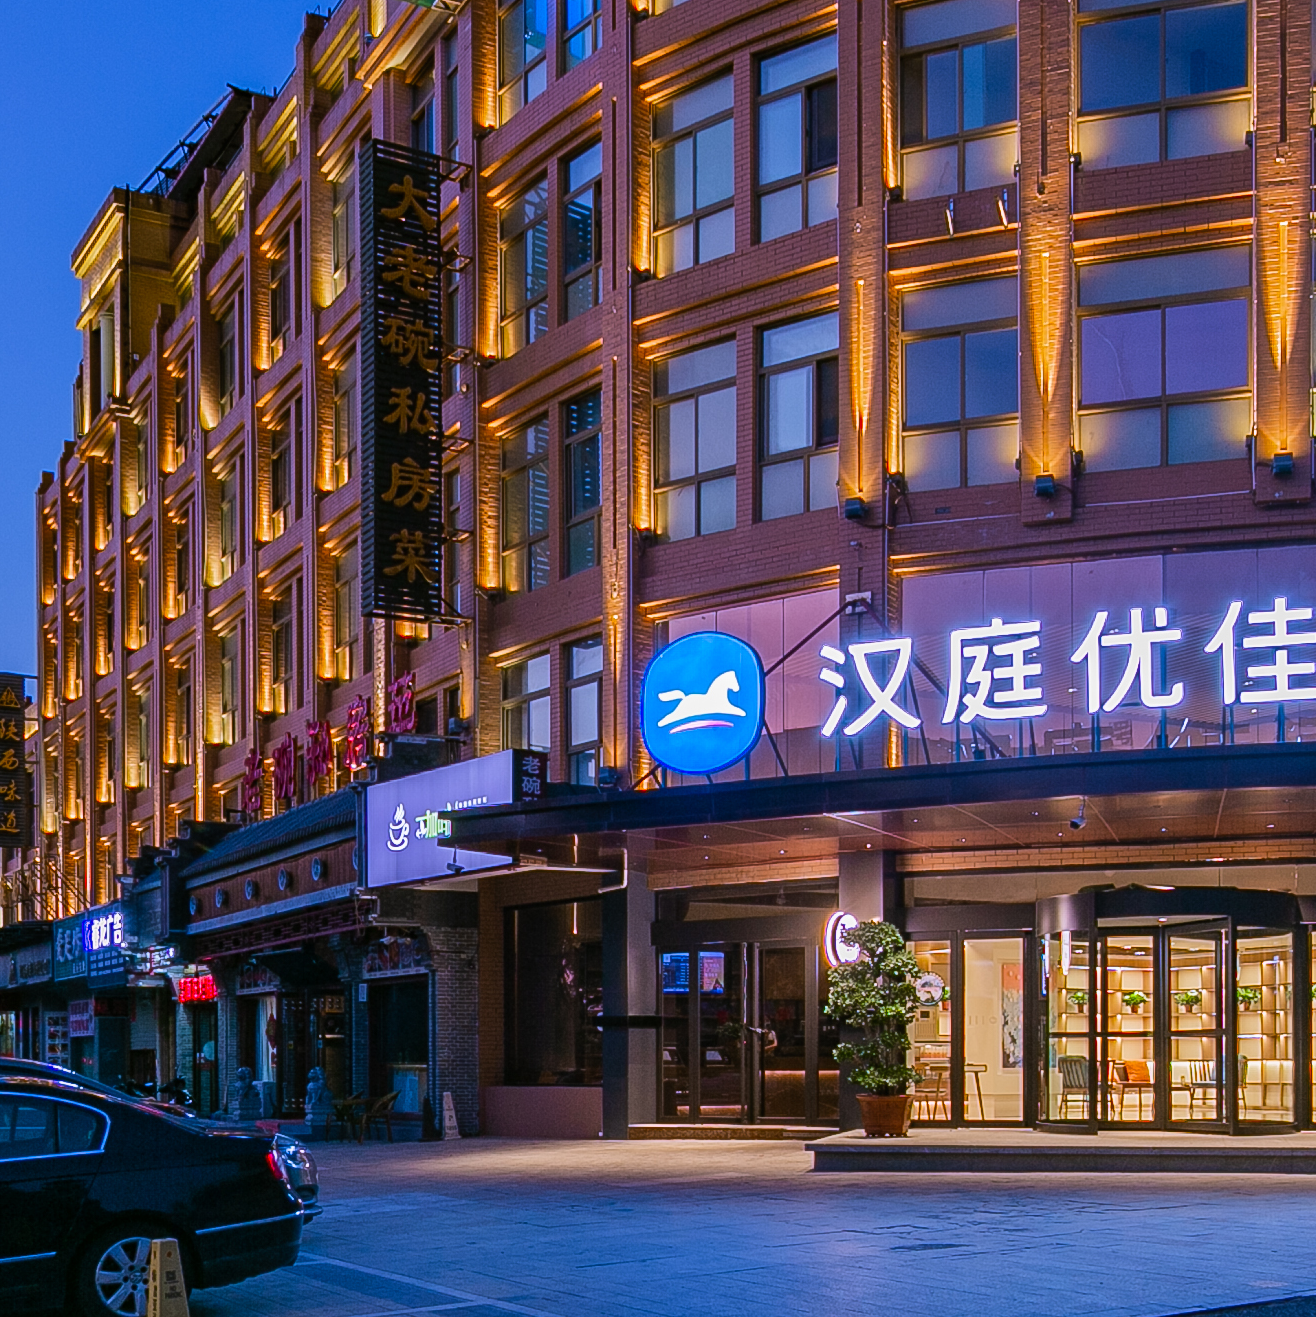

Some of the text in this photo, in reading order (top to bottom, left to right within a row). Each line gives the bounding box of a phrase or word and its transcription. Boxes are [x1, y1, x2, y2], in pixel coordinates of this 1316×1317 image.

[380, 174, 439, 584] 大老碗私房菜
[521, 755, 542, 801] 老碗
